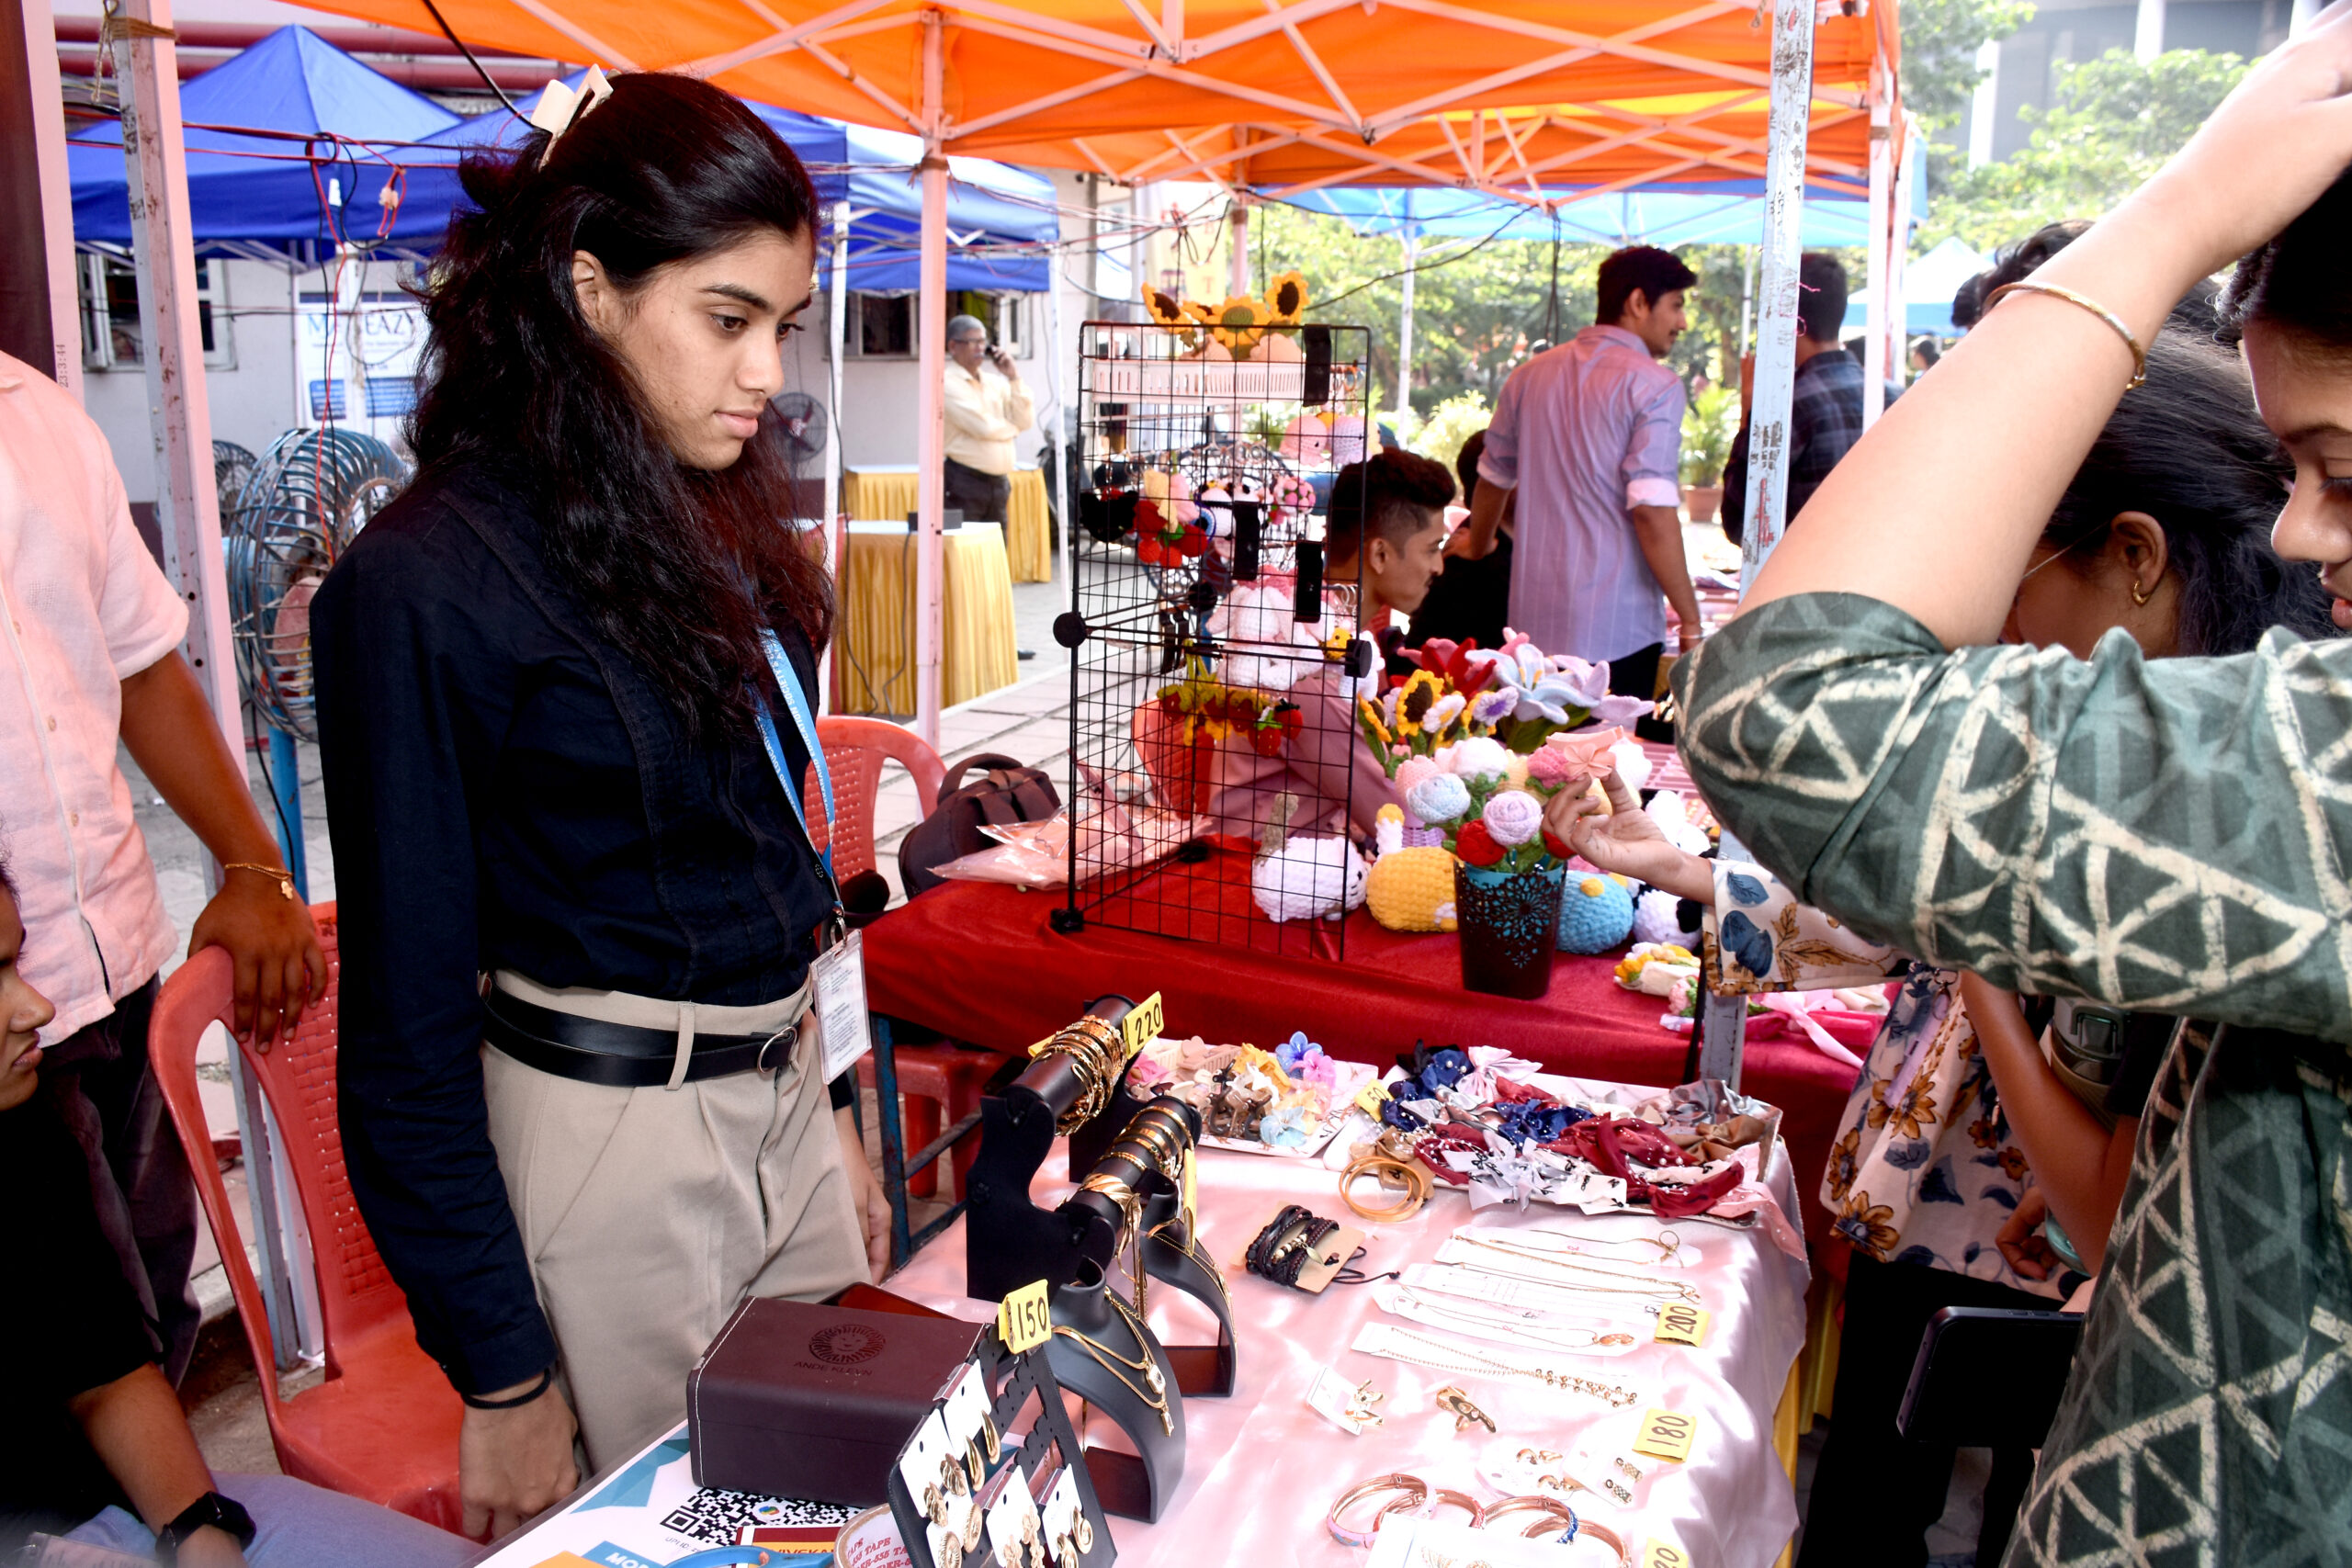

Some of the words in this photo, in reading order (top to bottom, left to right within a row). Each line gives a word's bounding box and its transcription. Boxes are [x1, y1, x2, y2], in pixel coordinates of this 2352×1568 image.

[1135, 1002, 1161, 1046] 220
[1017, 1296, 1047, 1341] 150
[1665, 1305, 1698, 1335] 200
[1646, 1416, 1690, 1448] 180
[865, 1537, 891, 1556] TAPE
